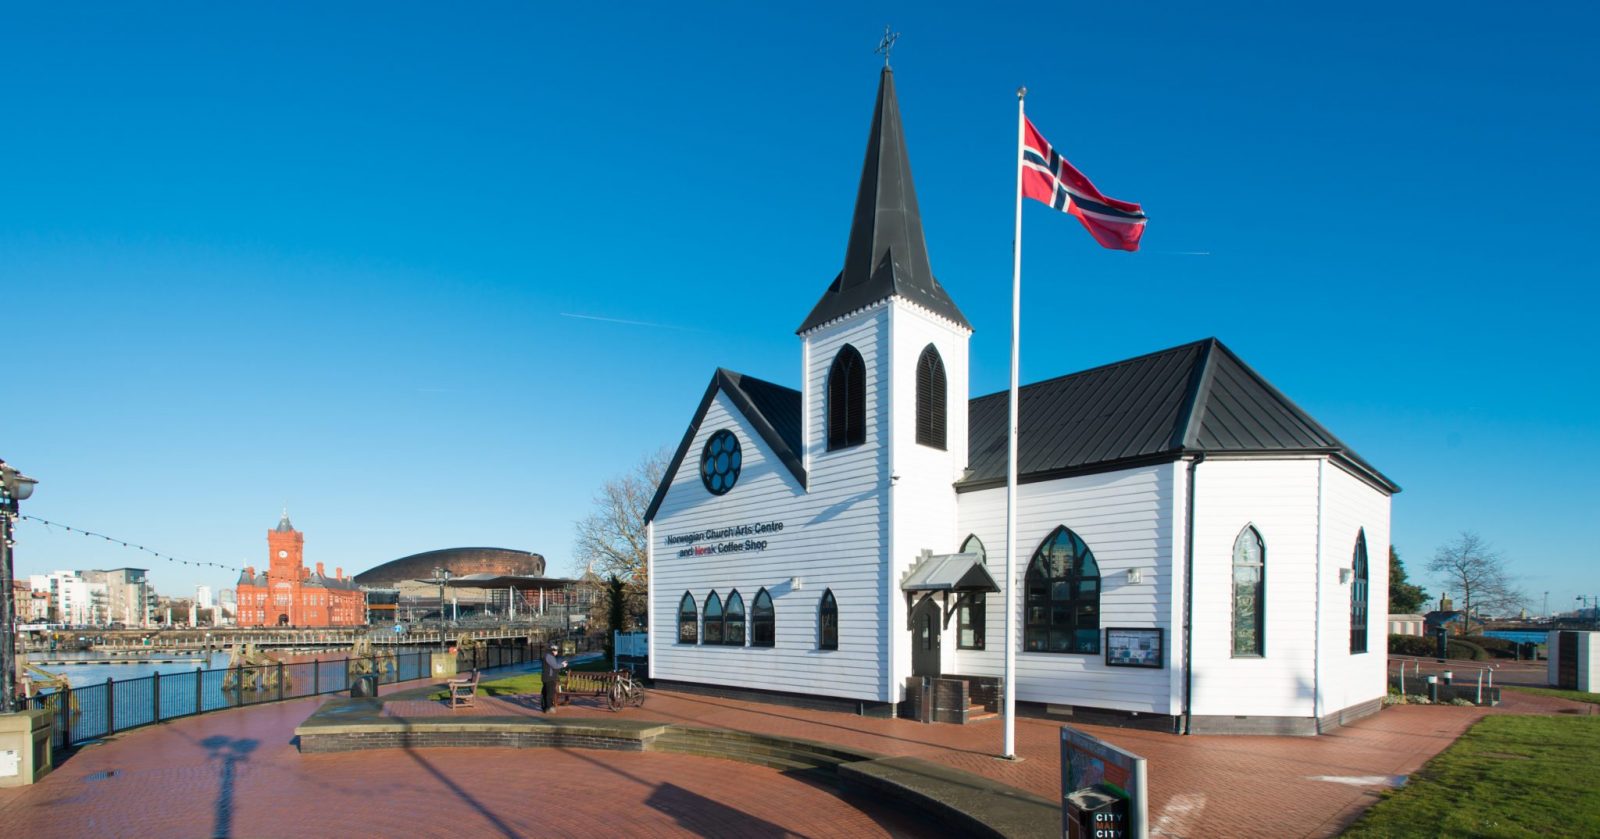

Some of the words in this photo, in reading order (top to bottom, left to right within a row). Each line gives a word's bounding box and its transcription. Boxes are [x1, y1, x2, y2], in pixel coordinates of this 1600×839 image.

[667, 532, 704, 545] Norwegian
[706, 526, 734, 540] Church
[735, 525, 753, 537] Arts
[755, 521, 784, 533] Centre
[679, 546, 693, 557] and
[718, 541, 743, 553] Coffee
[745, 539, 767, 551] Shop
[1096, 813, 1122, 821] CITY
[1096, 830, 1122, 838] CITY
